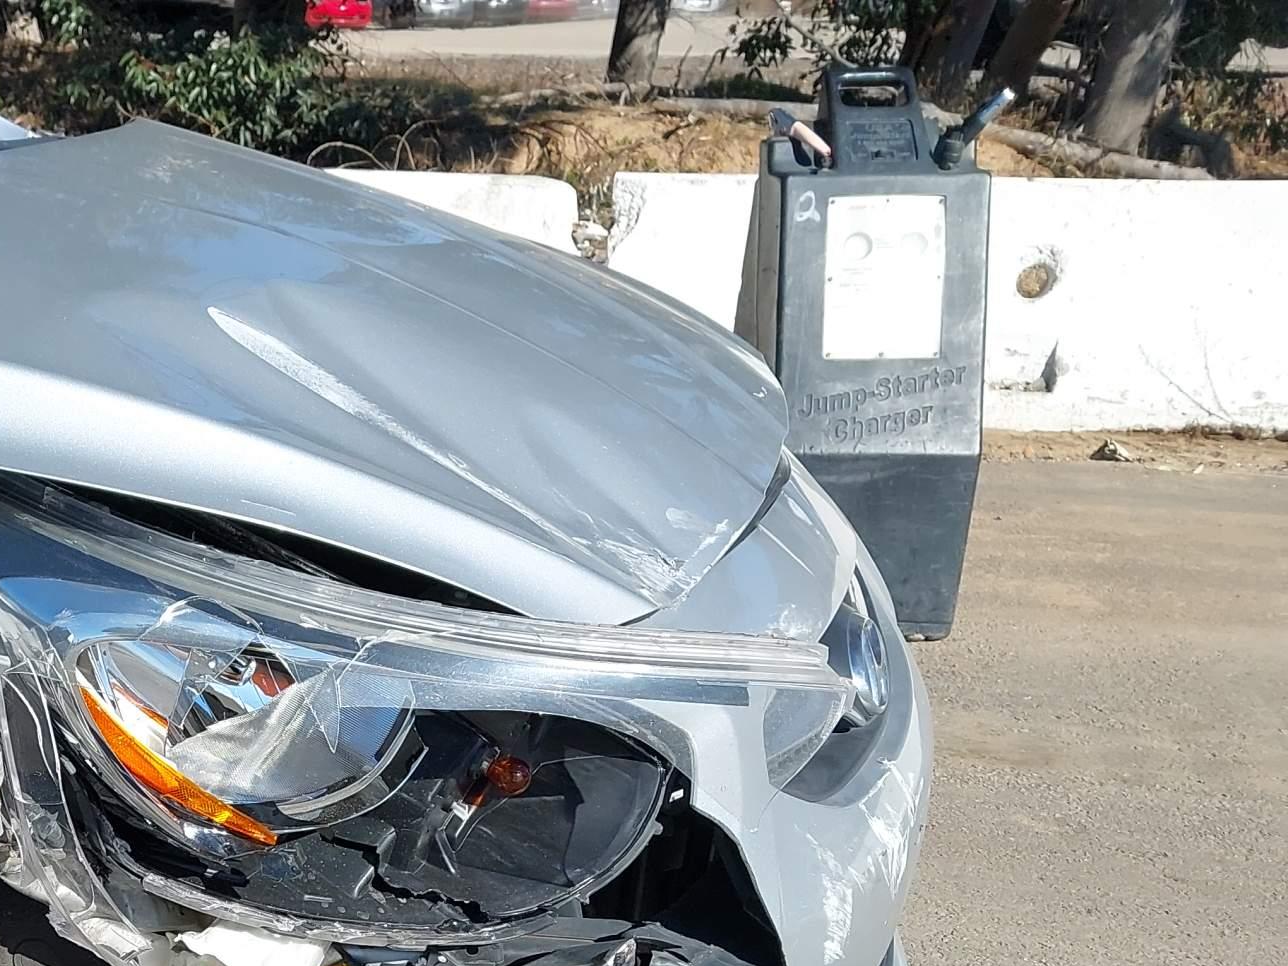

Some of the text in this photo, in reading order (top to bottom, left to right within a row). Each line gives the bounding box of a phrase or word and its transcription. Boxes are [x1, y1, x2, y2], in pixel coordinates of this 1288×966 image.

[795, 190, 821, 222] 2
[797, 366, 967, 418] Jump-Starter
[834, 405, 934, 443] Charger
